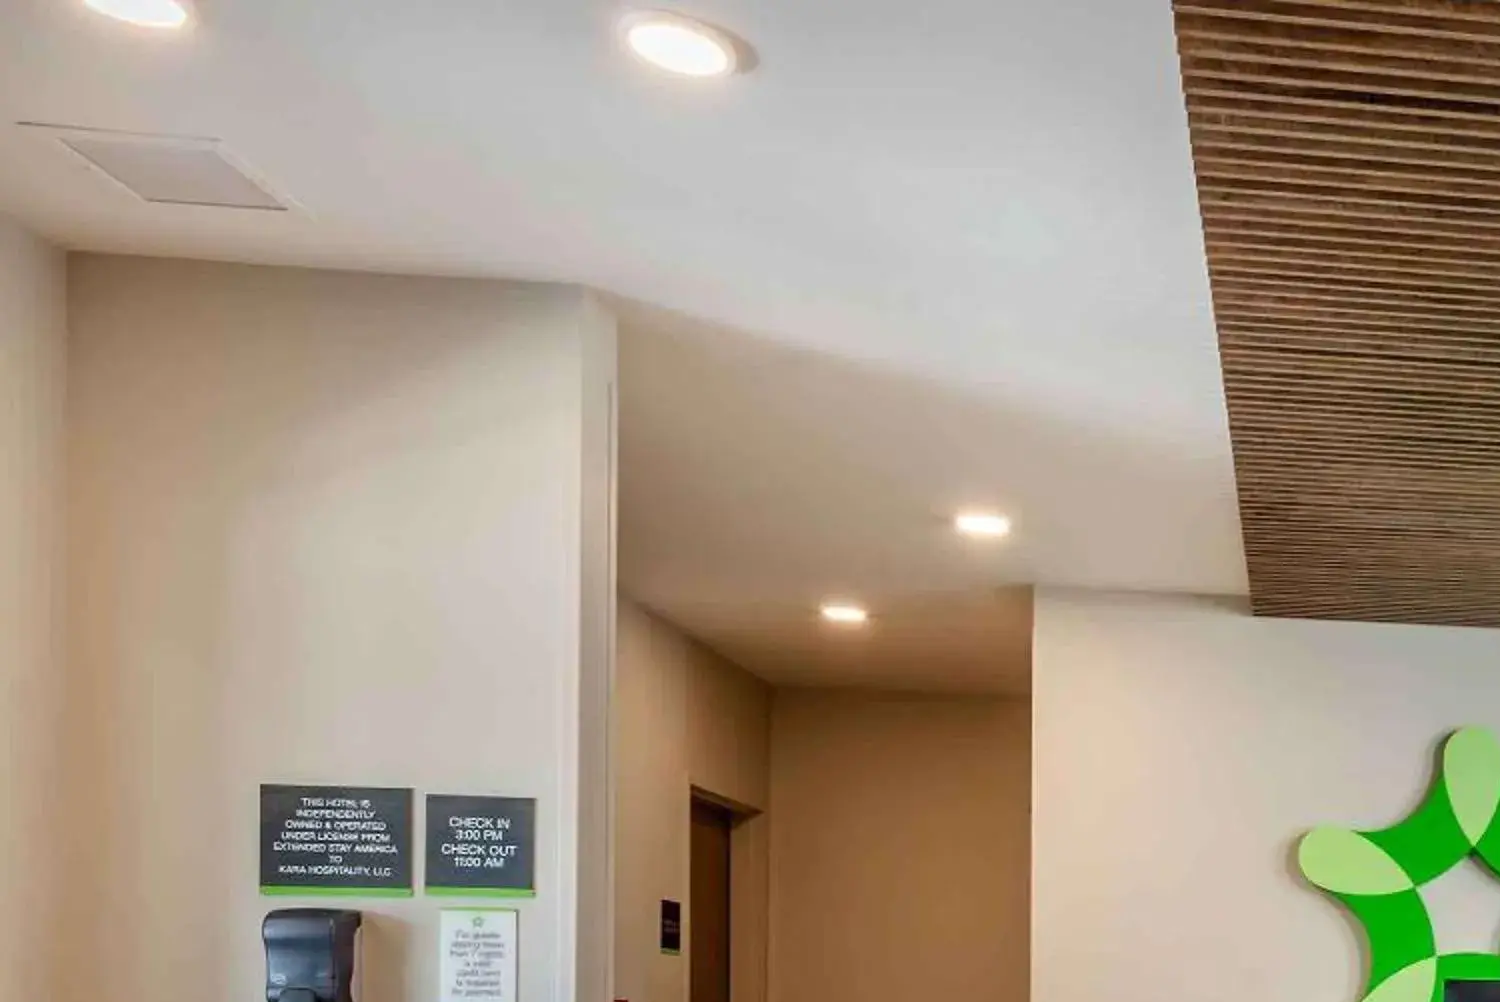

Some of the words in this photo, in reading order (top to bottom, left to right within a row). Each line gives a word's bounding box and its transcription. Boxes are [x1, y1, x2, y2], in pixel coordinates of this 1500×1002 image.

[300, 797, 324, 807] THIS
[326, 798, 358, 808] HOTEL
[361, 799, 371, 809] IS
[295, 809, 376, 819] INDEPENDENTLY
[284, 819, 322, 830] OWNED
[325, 821, 331, 829] &
[334, 821, 387, 831] OPERATED
[449, 816, 494, 829] CHECK
[497, 817, 511, 829] IN
[281, 831, 316, 841] UNDER
[361, 833, 391, 842] FROM
[455, 829, 480, 841] 3:00
[483, 829, 503, 841] PM
[273, 841, 326, 852] EXTENDED
[328, 843, 352, 853] STAY
[354, 844, 398, 855] AMERICA
[441, 843, 487, 855] CHECK
[489, 845, 518, 857] OUT
[328, 854, 343, 864] TO
[454, 856, 480, 868] 11:00
[484, 857, 505, 868] AM
